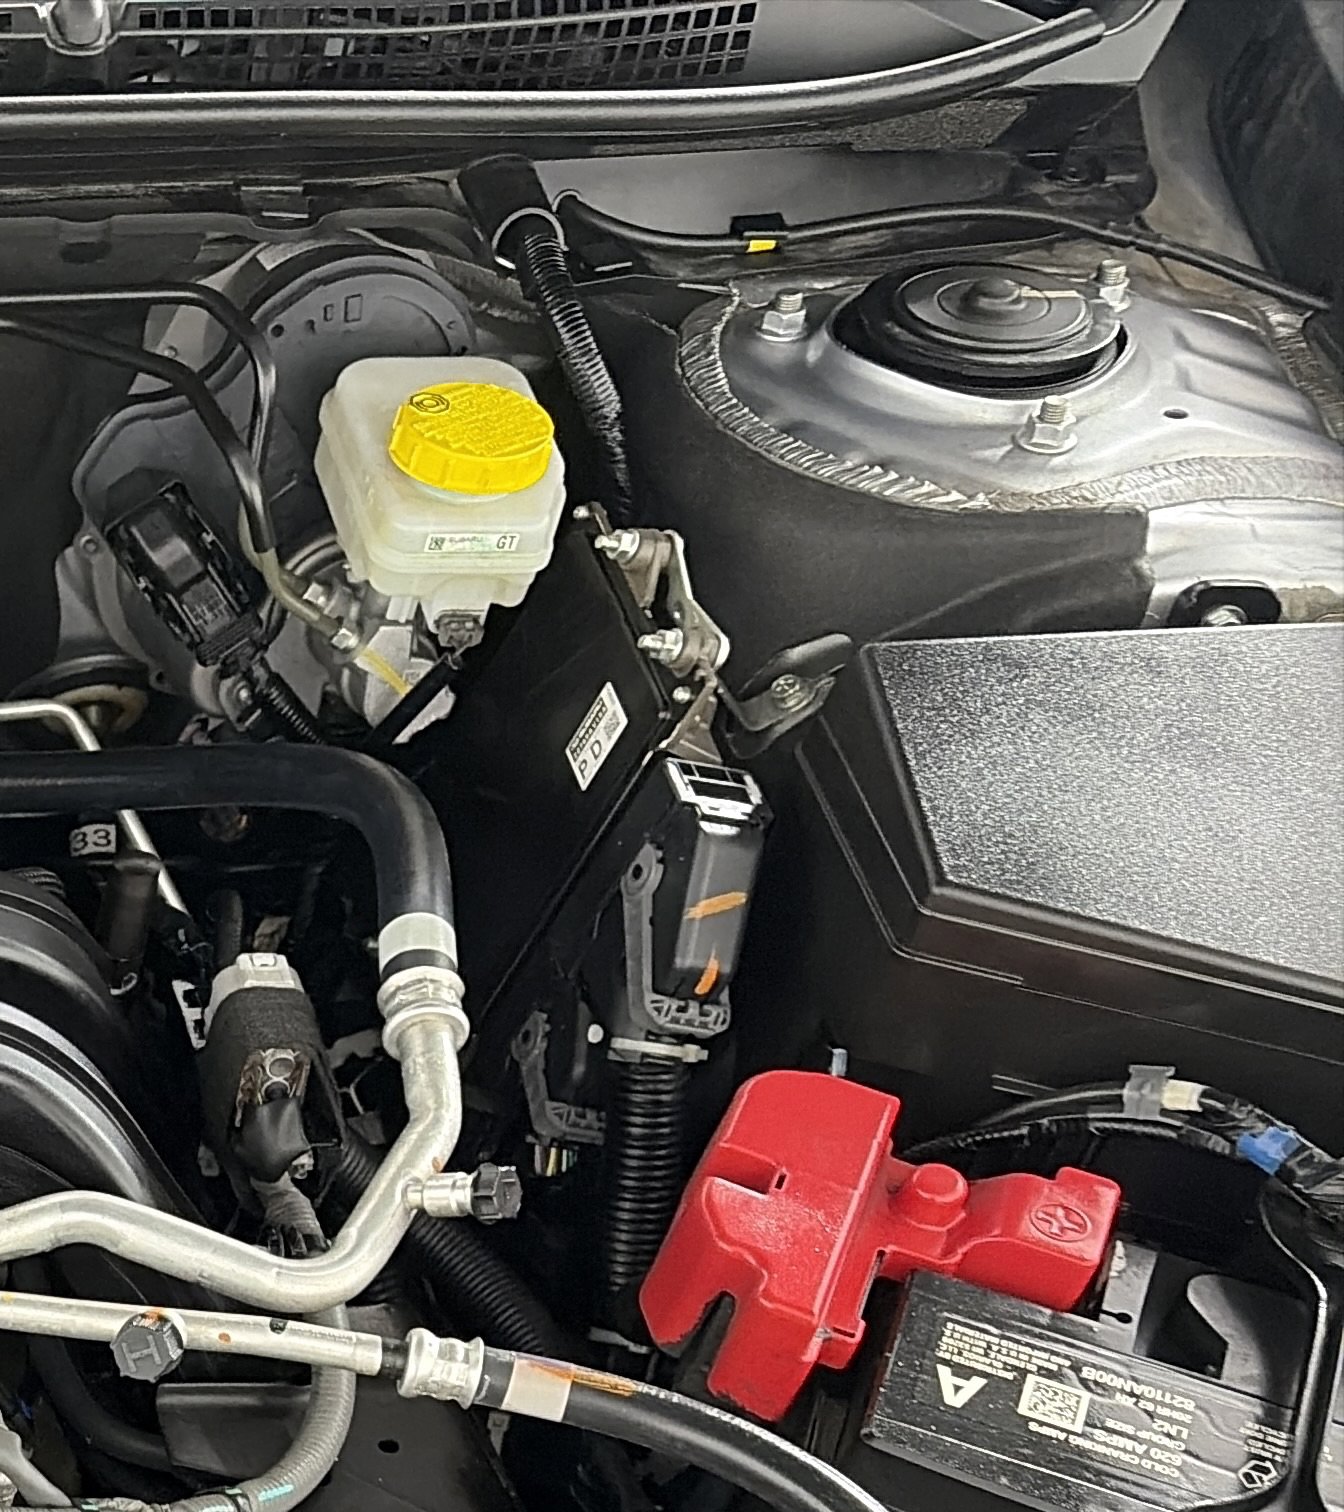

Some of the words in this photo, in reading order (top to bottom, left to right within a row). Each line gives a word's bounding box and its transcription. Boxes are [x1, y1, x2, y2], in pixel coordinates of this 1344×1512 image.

[496, 535, 517, 550] GT
[936, 1364, 989, 1408] A
[1027, 1421, 1068, 1441] AMPS
[1105, 1417, 1136, 1434] SIZE
[1152, 1418, 1189, 1440] LN2
[1068, 1434, 1140, 1464] CRANKING
[1093, 1429, 1147, 1454] AMPS
[1136, 1430, 1186, 1451] GROUP
[1149, 1448, 1182, 1466] 620
[1140, 1458, 1180, 1478] COLD
